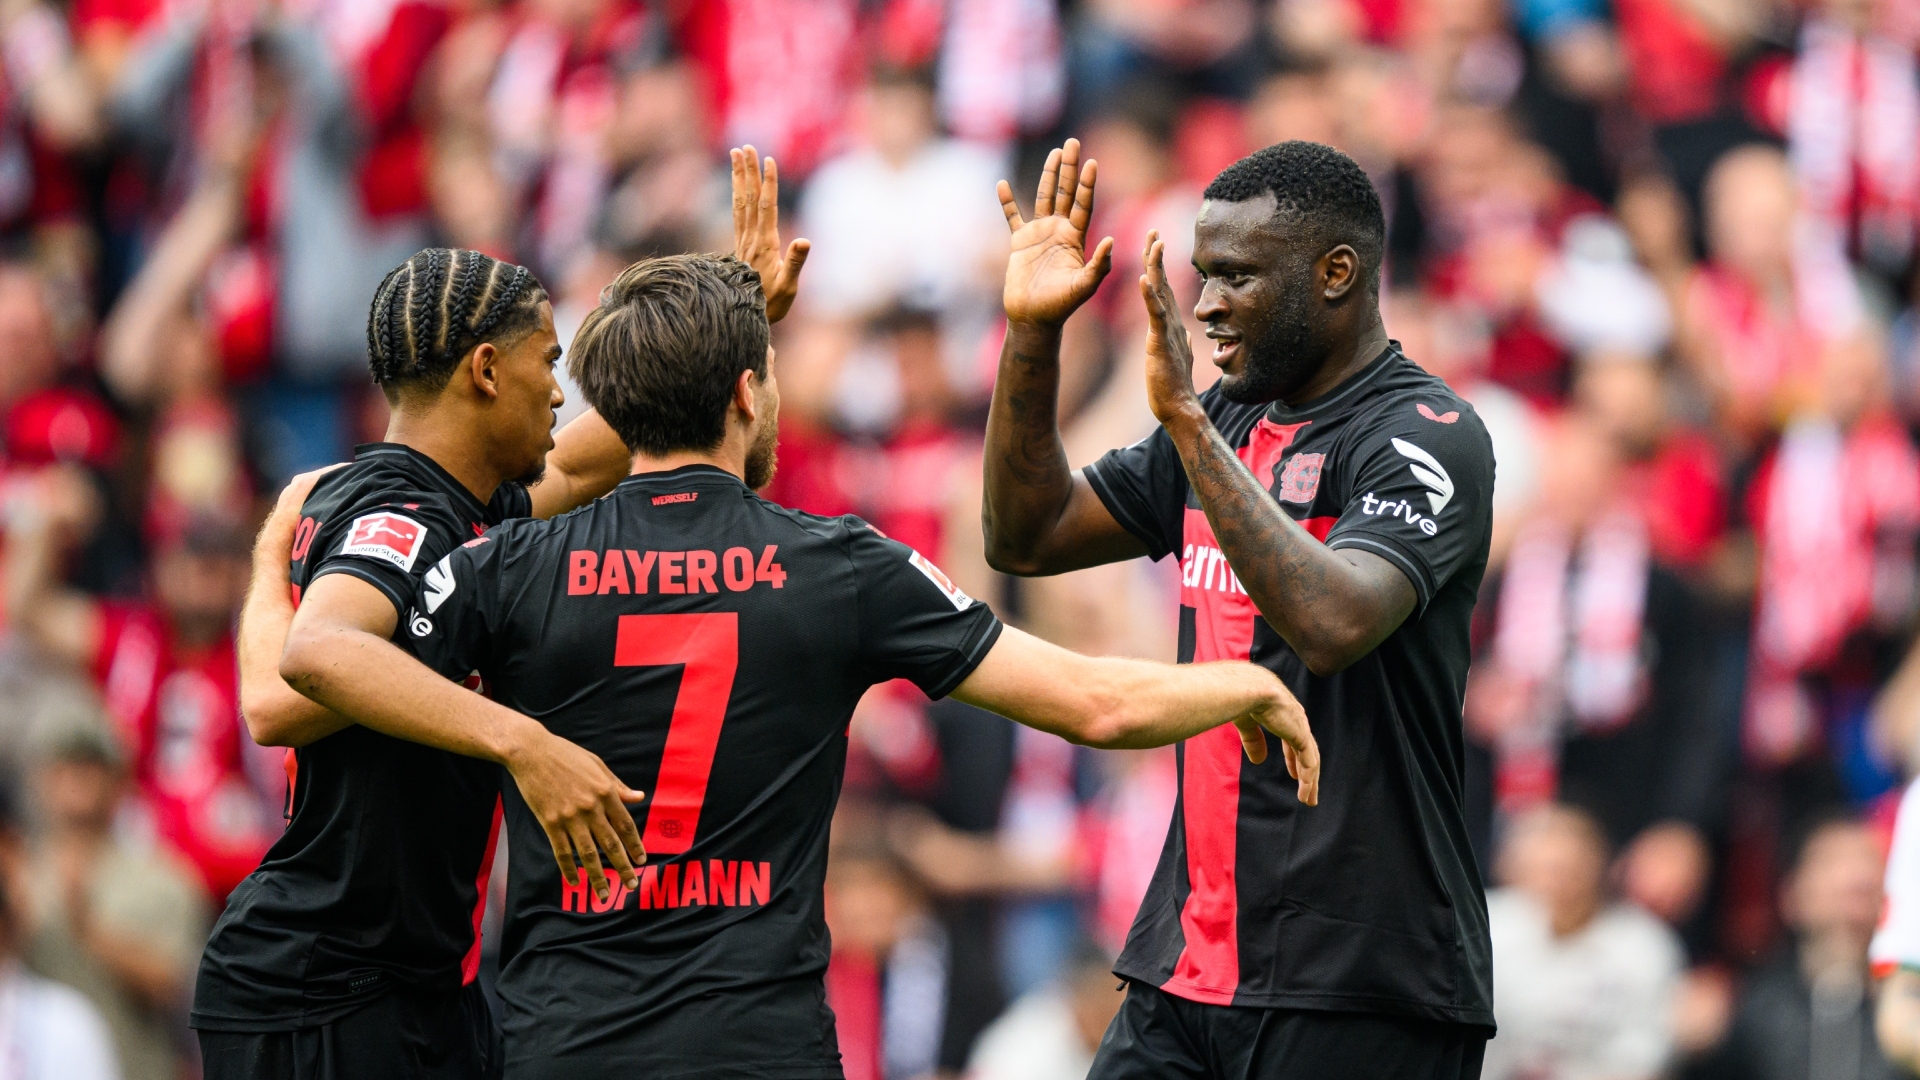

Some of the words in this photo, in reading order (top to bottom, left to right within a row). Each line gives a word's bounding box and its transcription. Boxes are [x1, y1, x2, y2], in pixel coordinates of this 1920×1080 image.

[651, 492, 698, 506] WERKSELF
[1362, 492, 1437, 536] trive
[347, 546, 405, 567] BUNDESLIGA
[567, 549, 719, 595] BAYER
[722, 544, 787, 592] 04
[614, 611, 739, 854] 7
[561, 859, 771, 914] HOFMANN
